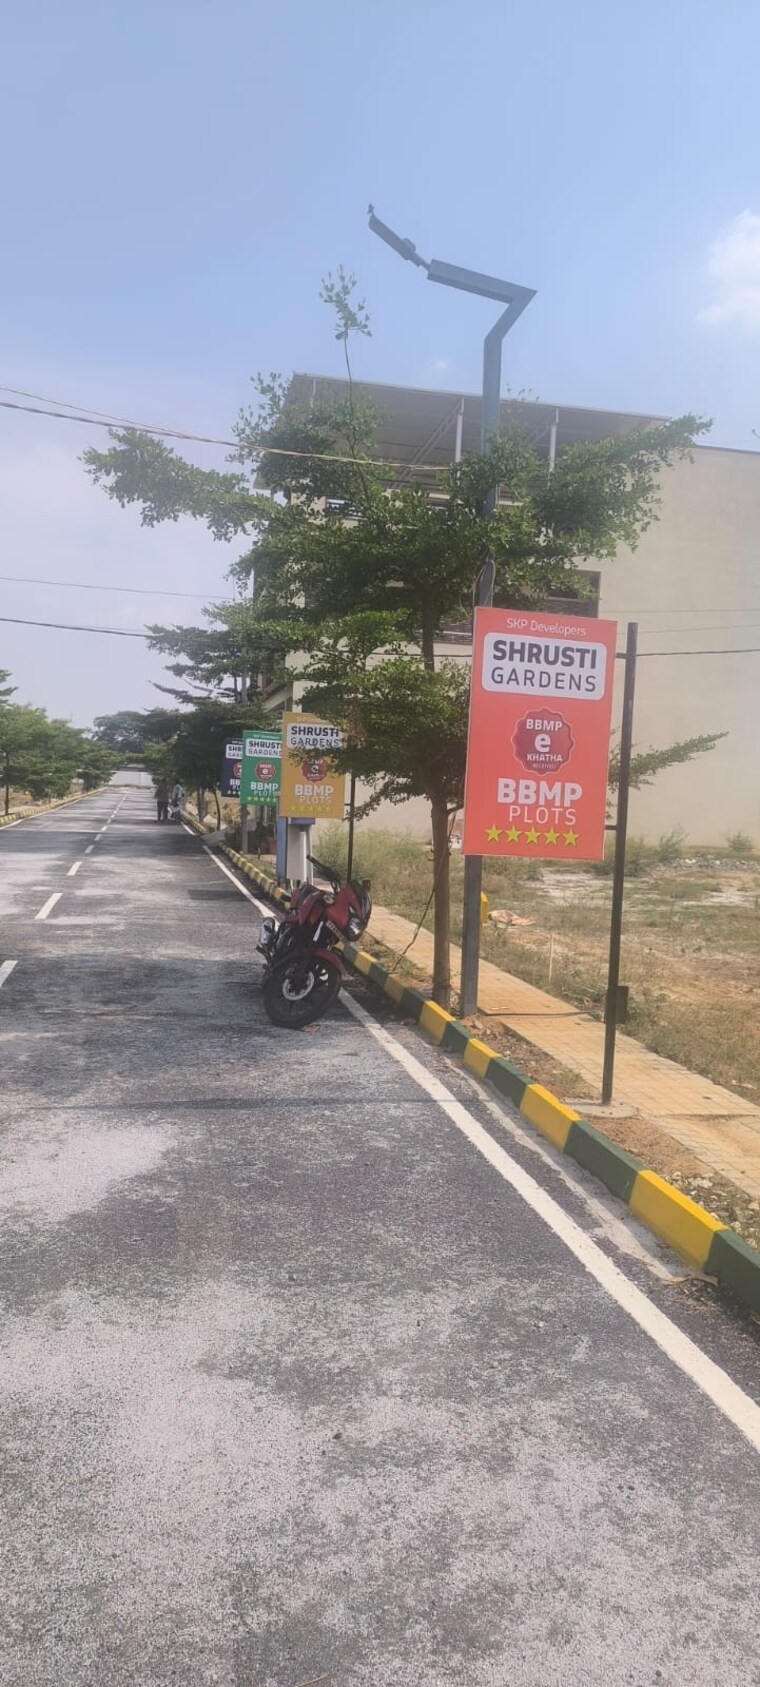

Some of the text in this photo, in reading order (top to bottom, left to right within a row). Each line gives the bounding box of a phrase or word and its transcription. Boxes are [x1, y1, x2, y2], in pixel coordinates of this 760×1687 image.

[506, 617, 587, 637] SKP Developers
[492, 639, 597, 670] SHRUSTI
[491, 666, 597, 692] GARDENS
[526, 718, 563, 732] BBMP
[534, 733, 552, 753] e
[526, 753, 563, 763] KHATHA
[250, 781, 279, 792] BBMP
[294, 784, 334, 797] BBMP
[497, 777, 583, 808] BBMP
[299, 795, 332, 805] PLOTS
[508, 805, 577, 825] PLOTS
